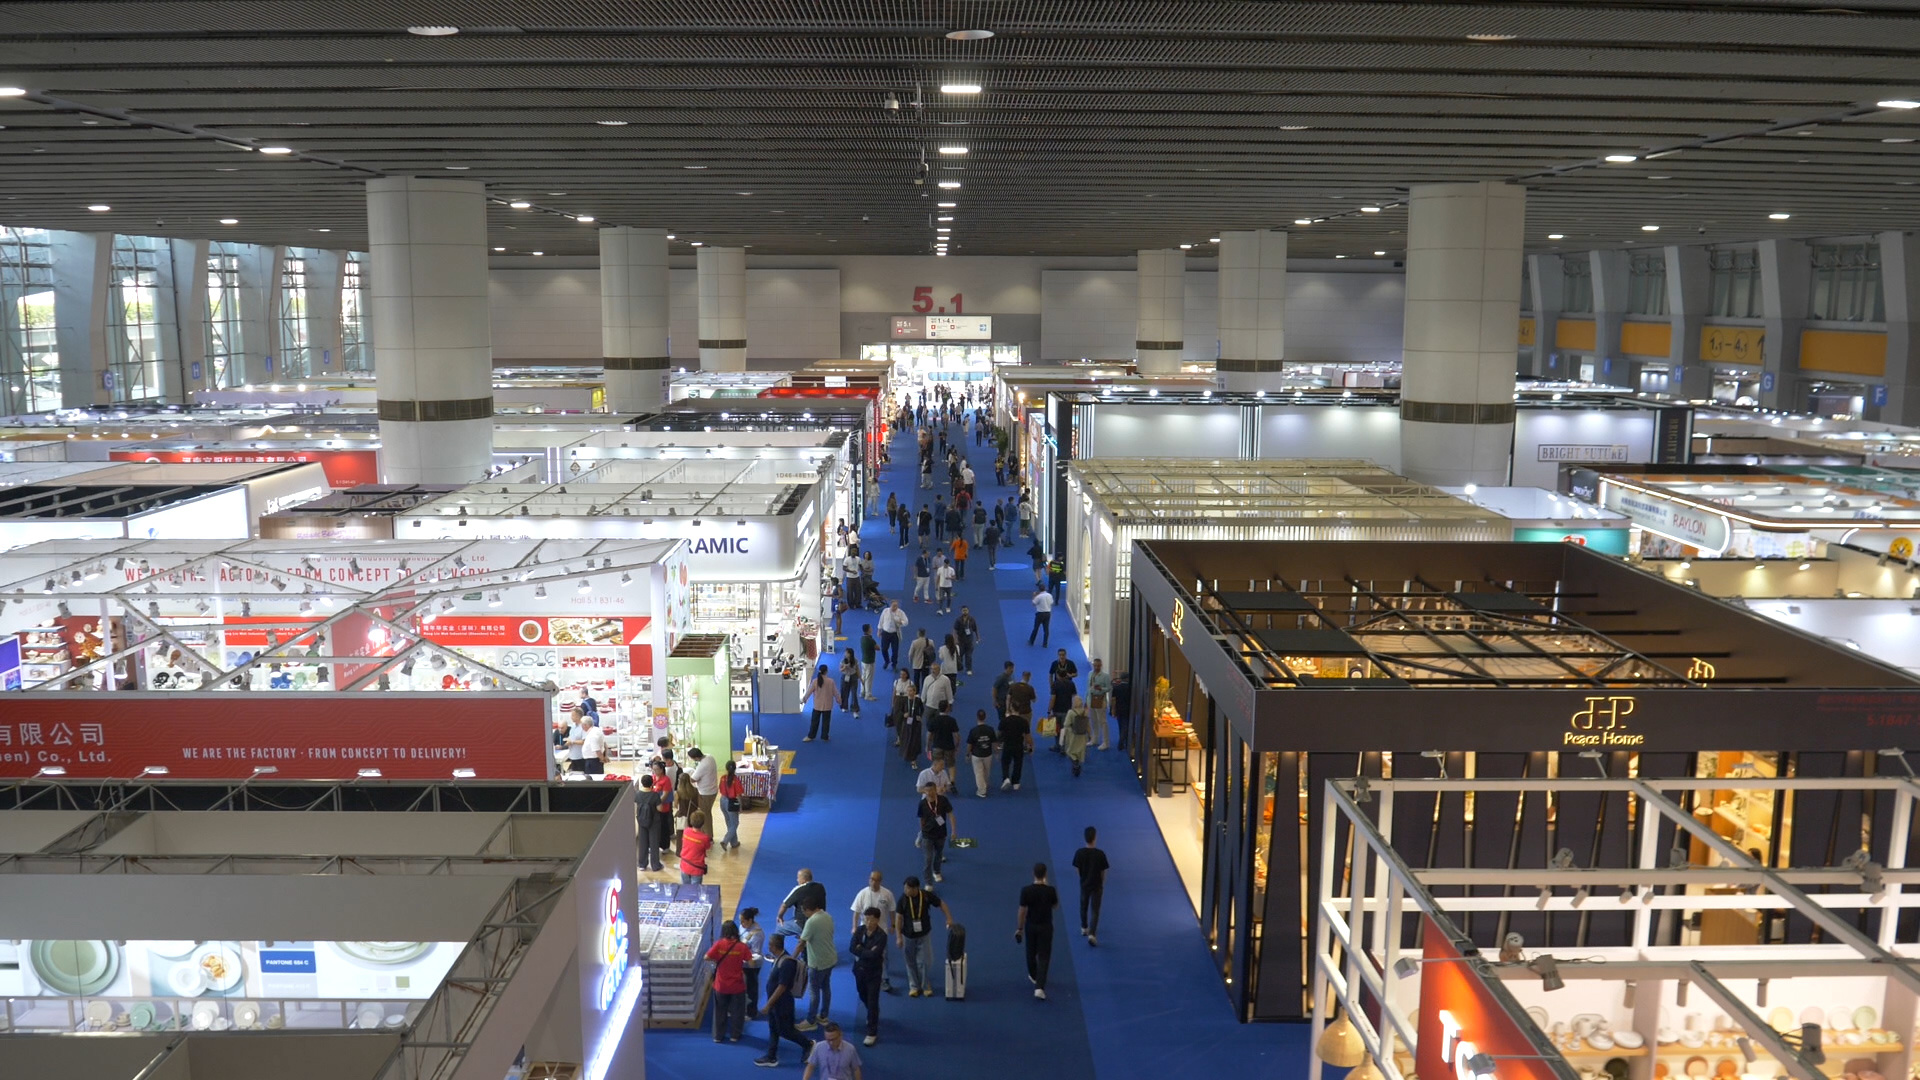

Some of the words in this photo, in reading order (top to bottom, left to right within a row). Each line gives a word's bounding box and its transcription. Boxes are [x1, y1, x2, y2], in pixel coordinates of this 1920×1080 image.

[912, 286, 963, 314] 5.1
[193, 364, 199, 377] H
[1674, 368, 1681, 380] H
[104, 374, 113, 387] G
[1763, 375, 1772, 390] G
[1875, 387, 1884, 404] F
[1542, 447, 1581, 460] BRIGHT
[1584, 447, 1624, 460] FUTURE
[1672, 513, 1707, 537] RAYLON
[330, 567, 391, 582] CONCEPT
[571, 596, 586, 604] Hall
[1563, 731, 1600, 746] Peace
[1602, 731, 1644, 746] Home
[37, 750, 72, 764] Co.,
[78, 750, 112, 762] Ltd.
[182, 747, 199, 759] WE
[202, 747, 223, 759] ARE
[226, 747, 246, 759] THE
[250, 747, 297, 759] FACTORY
[308, 747, 337, 759] FROM
[341, 747, 389, 759] CONCEPT
[392, 747, 407, 759] TO
[410, 747, 466, 759] DELIVERY!
